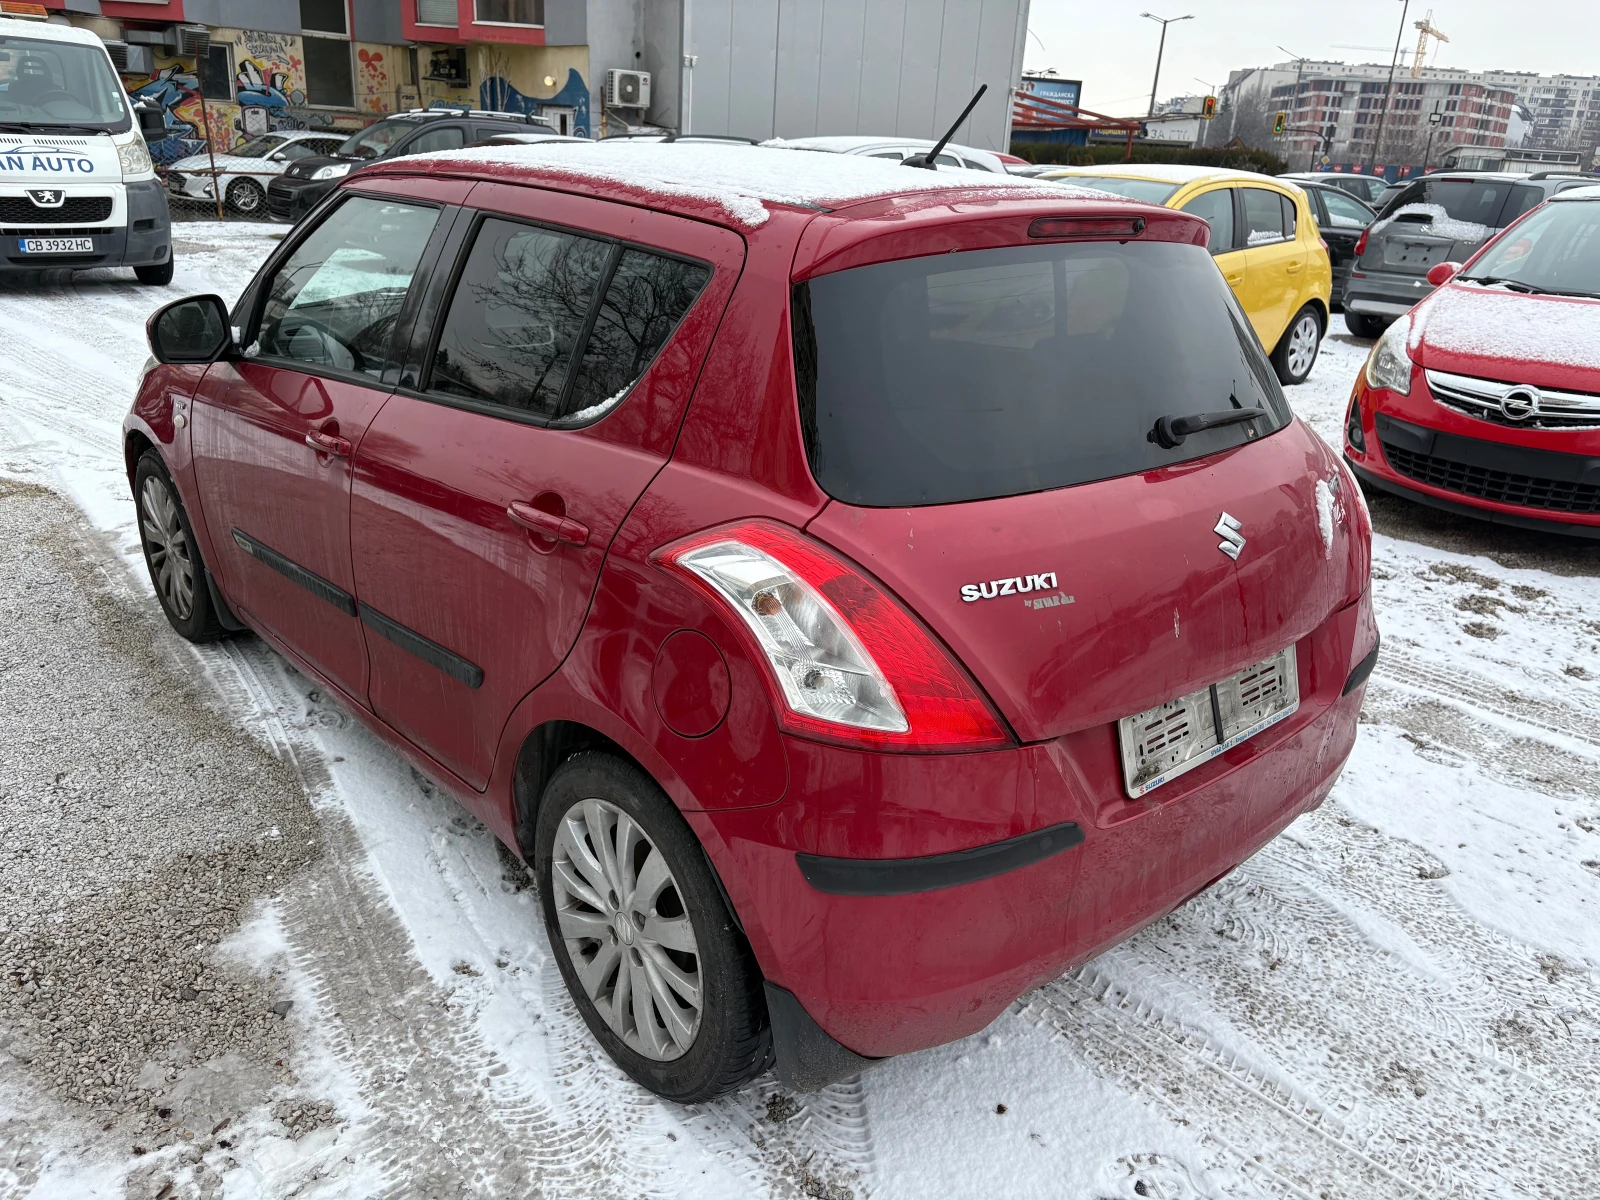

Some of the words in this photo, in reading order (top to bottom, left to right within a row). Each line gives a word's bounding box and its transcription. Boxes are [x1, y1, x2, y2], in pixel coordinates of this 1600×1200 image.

[1150, 128, 1165, 139] ЗА
[32, 156, 94, 174] AUTO
[27, 240, 43, 251] CB
[45, 240, 74, 250] 3932
[75, 239, 91, 250] HC
[960, 572, 1058, 602] SUZUKI
[1024, 599, 1033, 608] by
[1033, 596, 1061, 610] SIVAR
[1210, 747, 1222, 757] SIVAR
[1235, 733, 1248, 744] Reggio
[1145, 775, 1165, 791] SUZUKI
